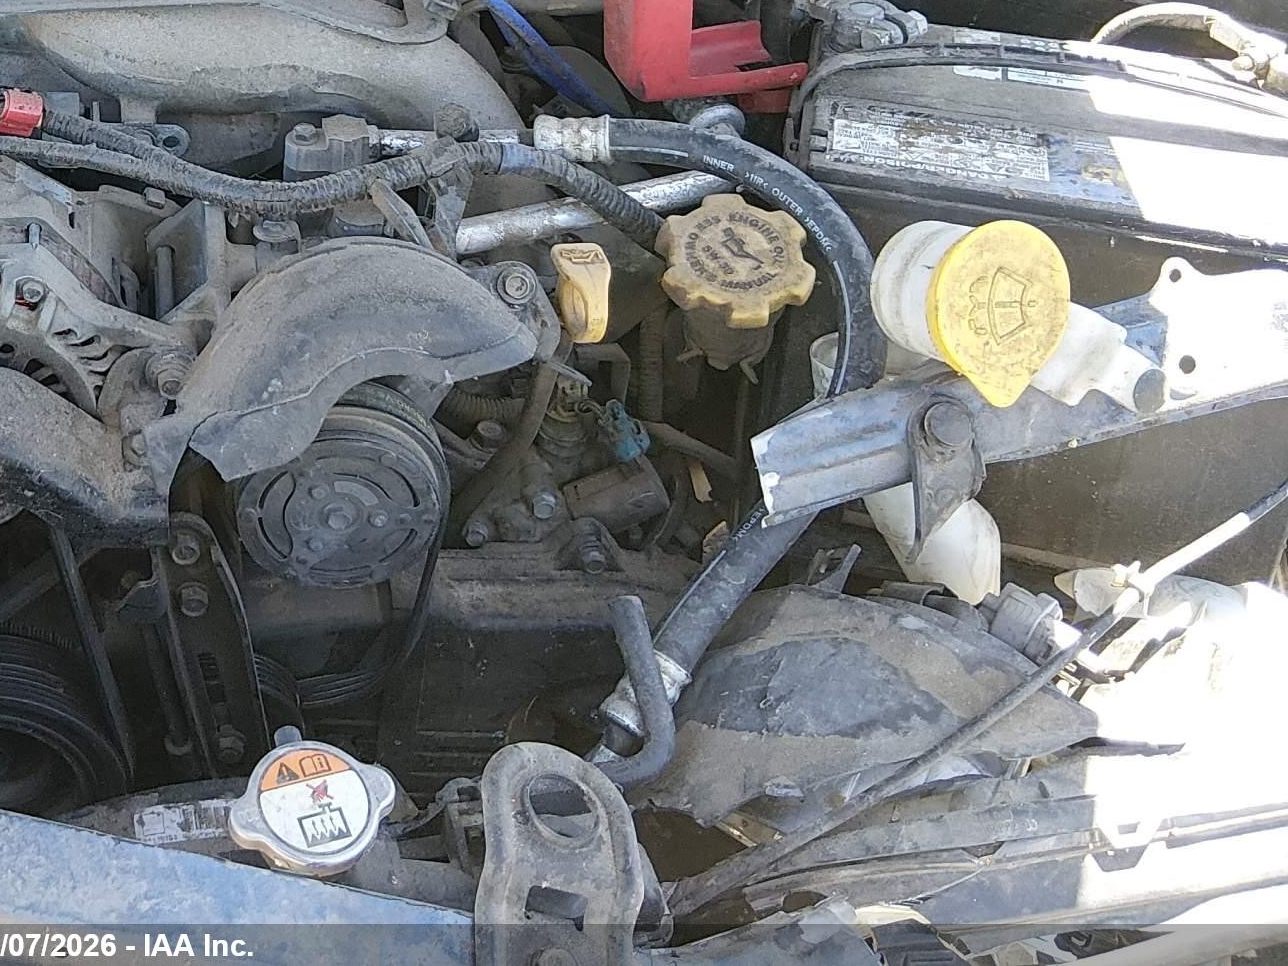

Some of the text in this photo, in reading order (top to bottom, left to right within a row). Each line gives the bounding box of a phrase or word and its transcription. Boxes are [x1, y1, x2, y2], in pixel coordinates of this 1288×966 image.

[703, 154, 735, 173] INNER
[772, 187, 803, 217] OUTER
[728, 211, 780, 245] ENGINE
